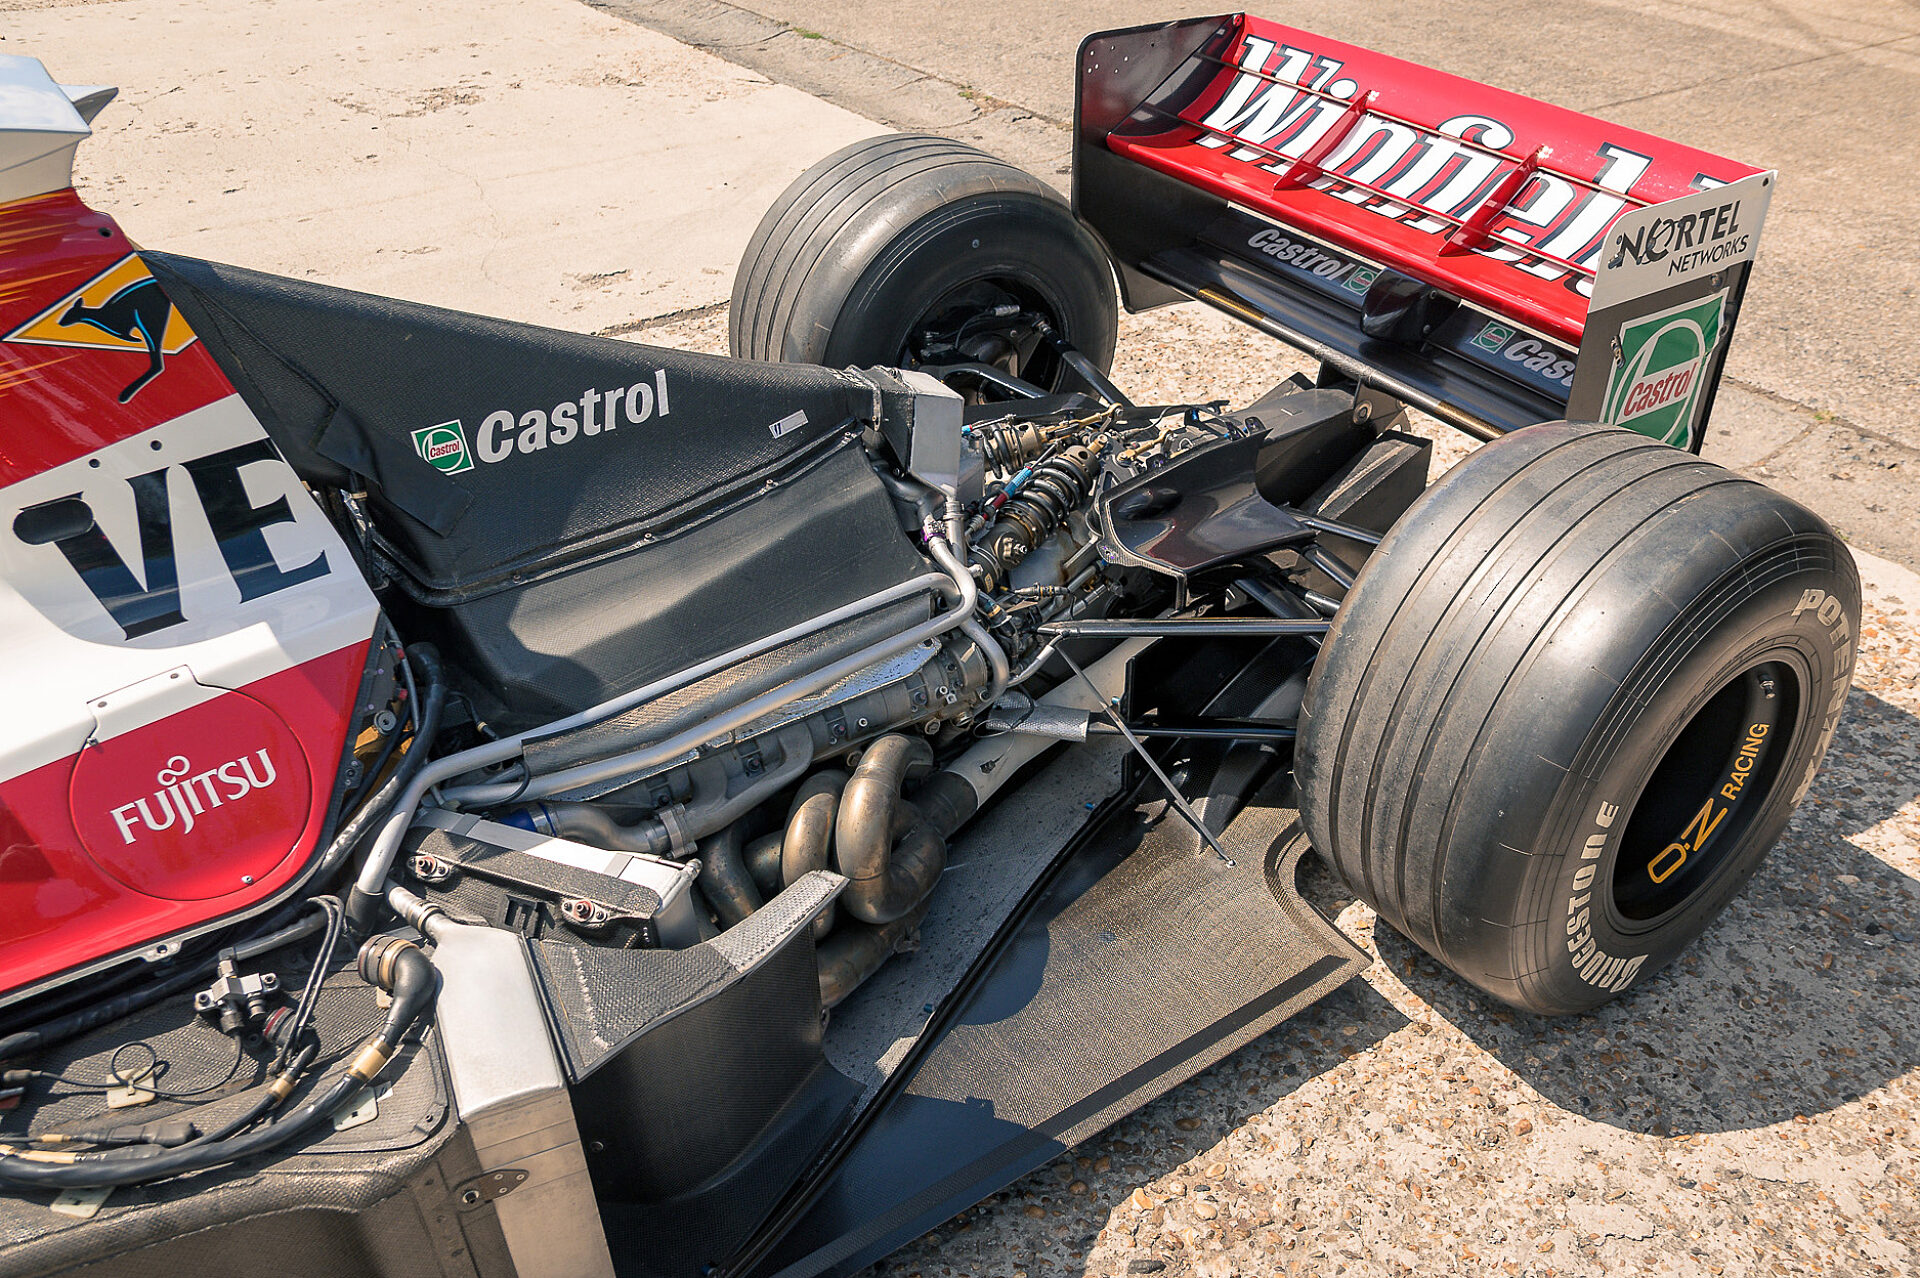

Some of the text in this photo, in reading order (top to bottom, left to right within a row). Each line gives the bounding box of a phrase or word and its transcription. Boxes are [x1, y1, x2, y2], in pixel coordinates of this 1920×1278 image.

[1247, 228, 1356, 281] Castrol
[1610, 200, 1741, 268] NORTEL
[1668, 234, 1749, 276] NETWORKS
[476, 368, 670, 464] Castrol
[1623, 361, 1699, 417] Castrol
[429, 440, 460, 458] Castrol
[1720, 722, 1771, 801] RACING
[110, 748, 277, 845] FUJITSU
[1566, 800, 1649, 993] BRIDGESTONE
